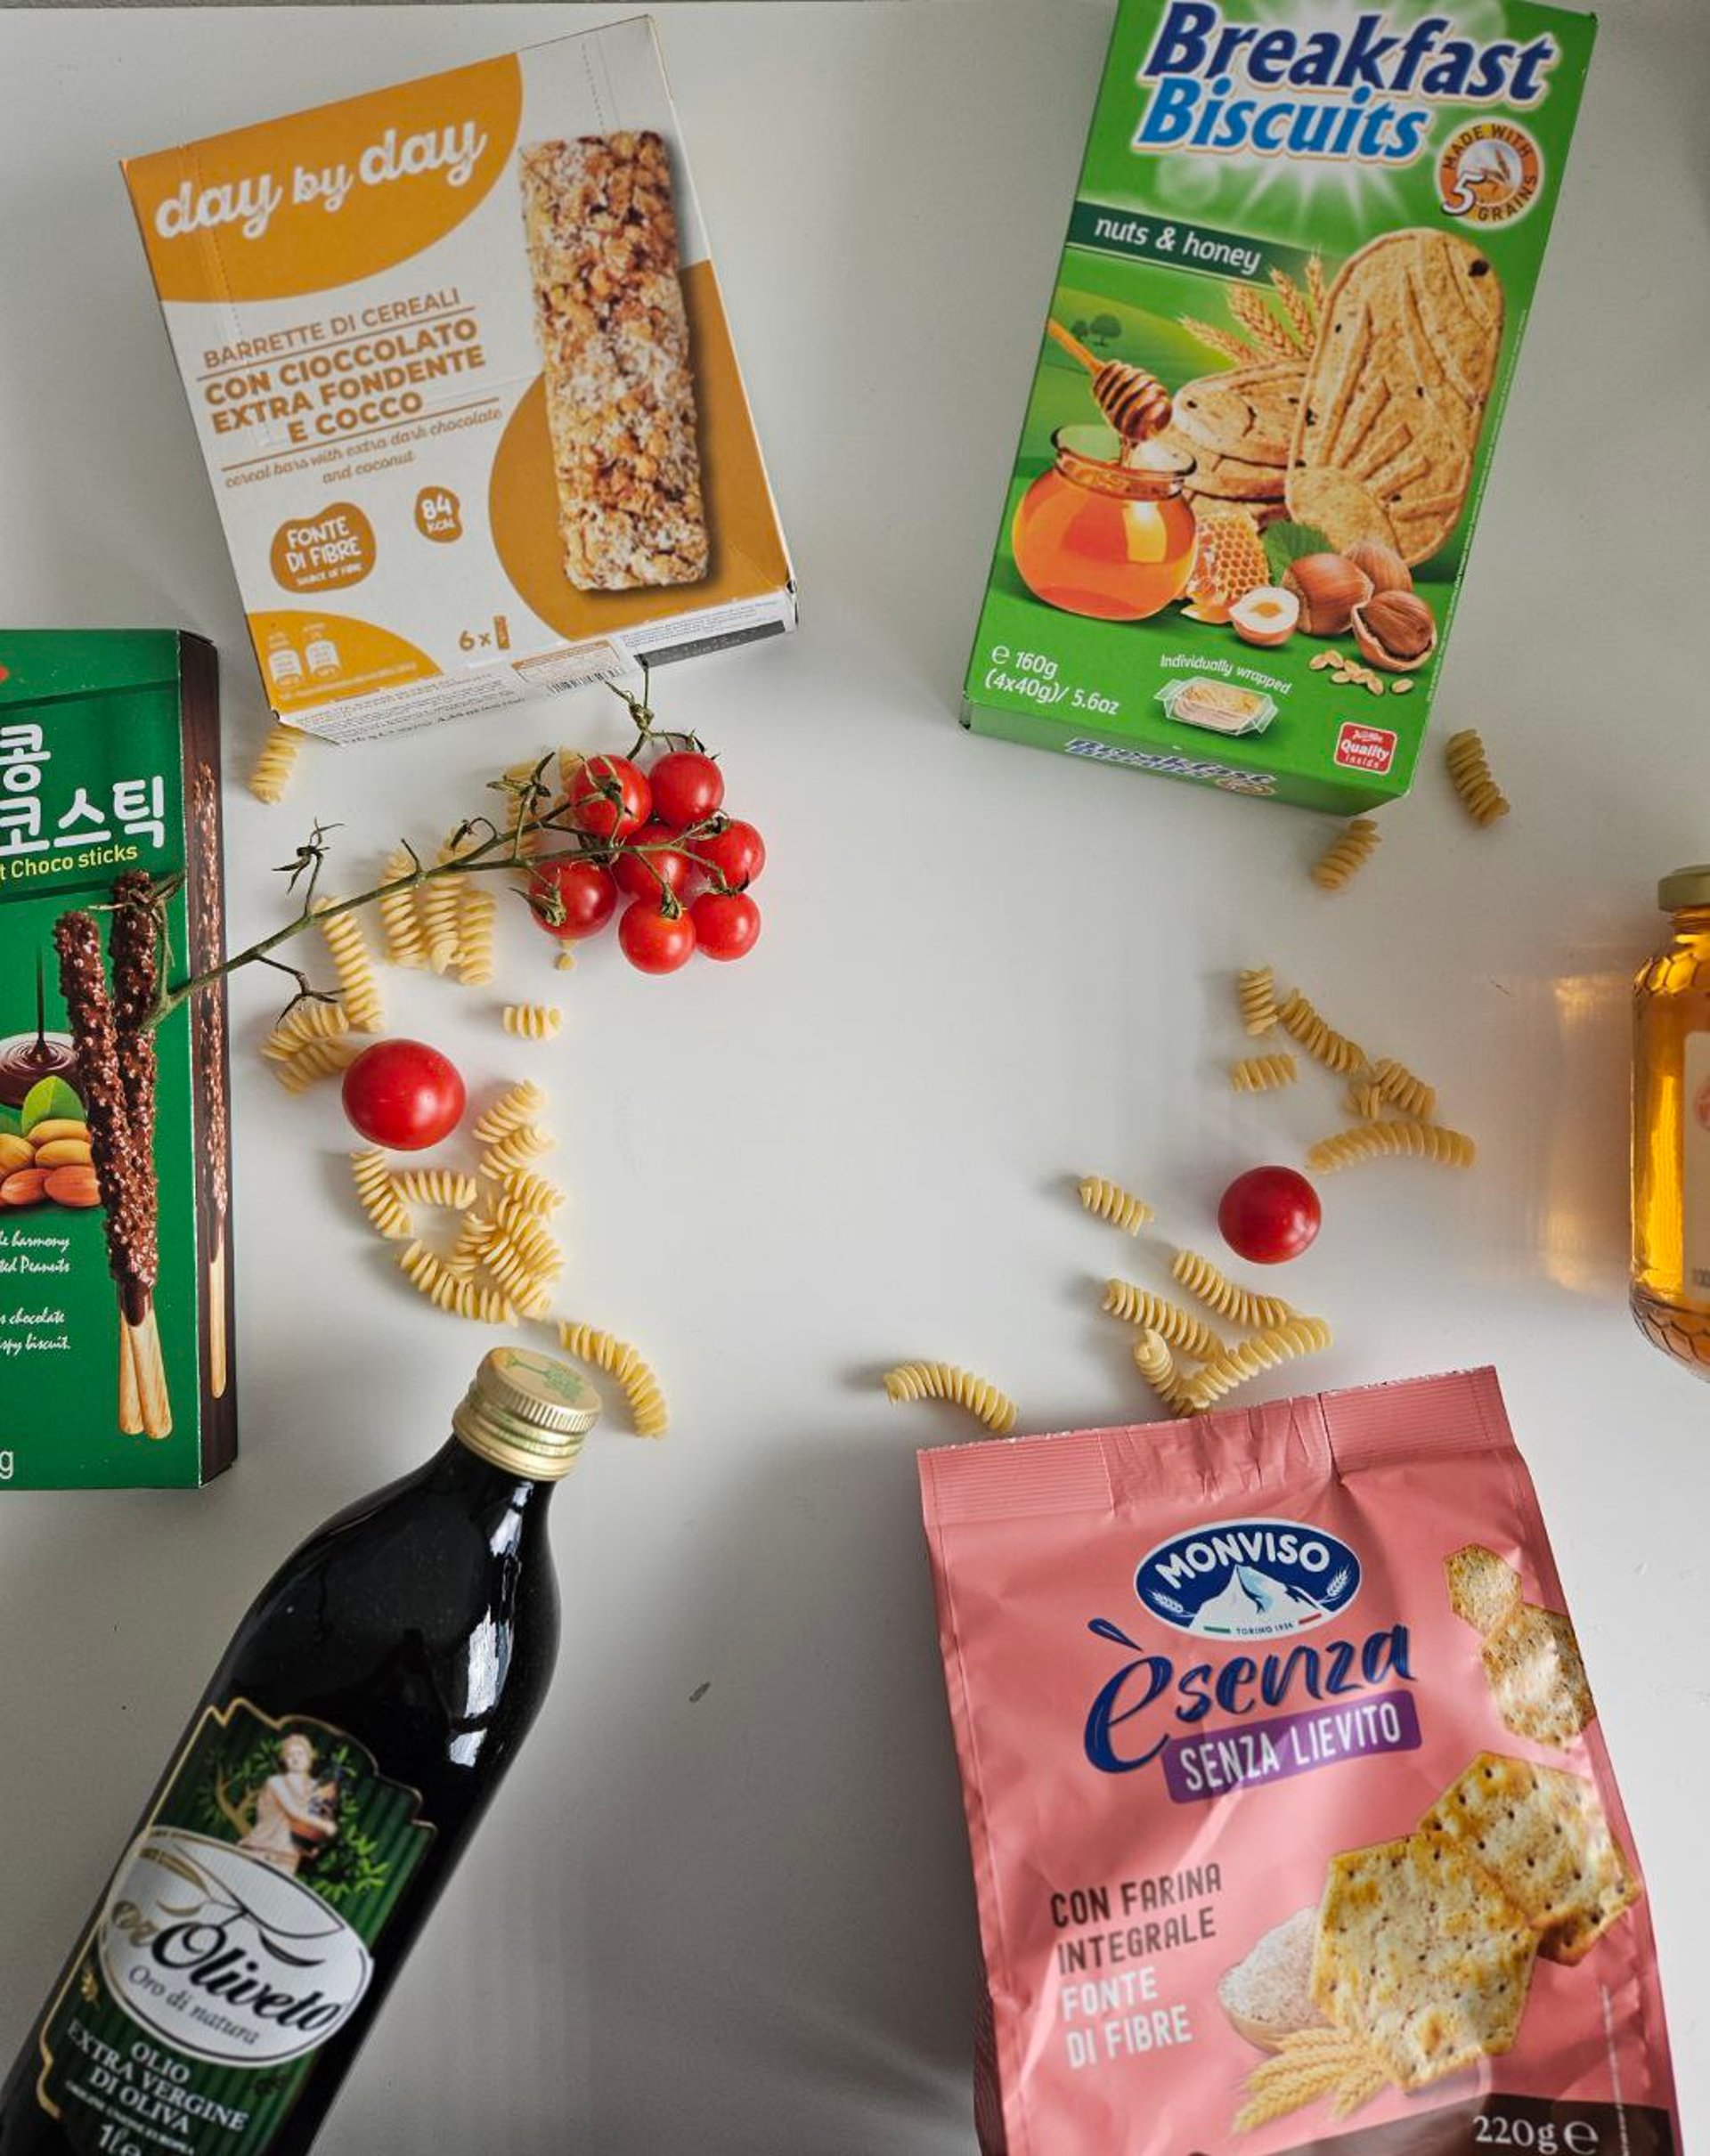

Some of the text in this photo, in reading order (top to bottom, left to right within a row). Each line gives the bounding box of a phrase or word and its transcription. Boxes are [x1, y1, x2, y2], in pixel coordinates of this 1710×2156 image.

[1143, 1, 1554, 102] Breakfast
[1137, 76, 1429, 159] Biscuits
[155, 121, 488, 239] day by day
[1440, 123, 1537, 222] MADE WITH 5 GRAINS
[1094, 217, 1262, 275] nuts & honey
[203, 287, 460, 370] BARRETTE DI CEREALI
[205, 318, 478, 406] CON CIOCCOLATO
[212, 345, 486, 435] EXTRA FONDENTE
[288, 391, 423, 444] E COCCO
[225, 408, 504, 488] cereal bars with extra dark chocolate
[322, 448, 416, 485] and coconut
[286, 516, 350, 549] FONTE
[421, 493, 452, 519] 84
[285, 536, 362, 574] DI FIBRE
[1015, 650, 1058, 679] 160g
[1160, 653, 1293, 696] Individually wrapped
[1070, 687, 1120, 716] 5.6oz
[1340, 738, 1389, 762] Quality
[11, 857, 74, 879] Choco
[78, 843, 139, 868] sticks
[12, 1229, 71, 1255] harmony
[20, 1254, 71, 1274] Peanuts
[9, 1306, 66, 1325] chocolate
[1154, 1531, 1331, 1591] MONVISO
[1179, 1701, 1403, 1792] SENZA LIEVITO
[1049, 1862, 1222, 1929] CON FARINA
[1057, 1906, 1217, 1975] INTEGRALE
[128, 1965, 261, 2046] Oro di natura
[1061, 1965, 1159, 2022] FONTE
[130, 2040, 191, 2085] OLIO
[1066, 2004, 1193, 2070] DI FIBRE
[66, 2017, 134, 2083] EXTRA
[141, 2070, 250, 2132] VERGINE
[88, 2065, 120, 2095] DI
[118, 2085, 191, 2135] OLIVA
[1472, 2115, 1559, 2155] 220g
